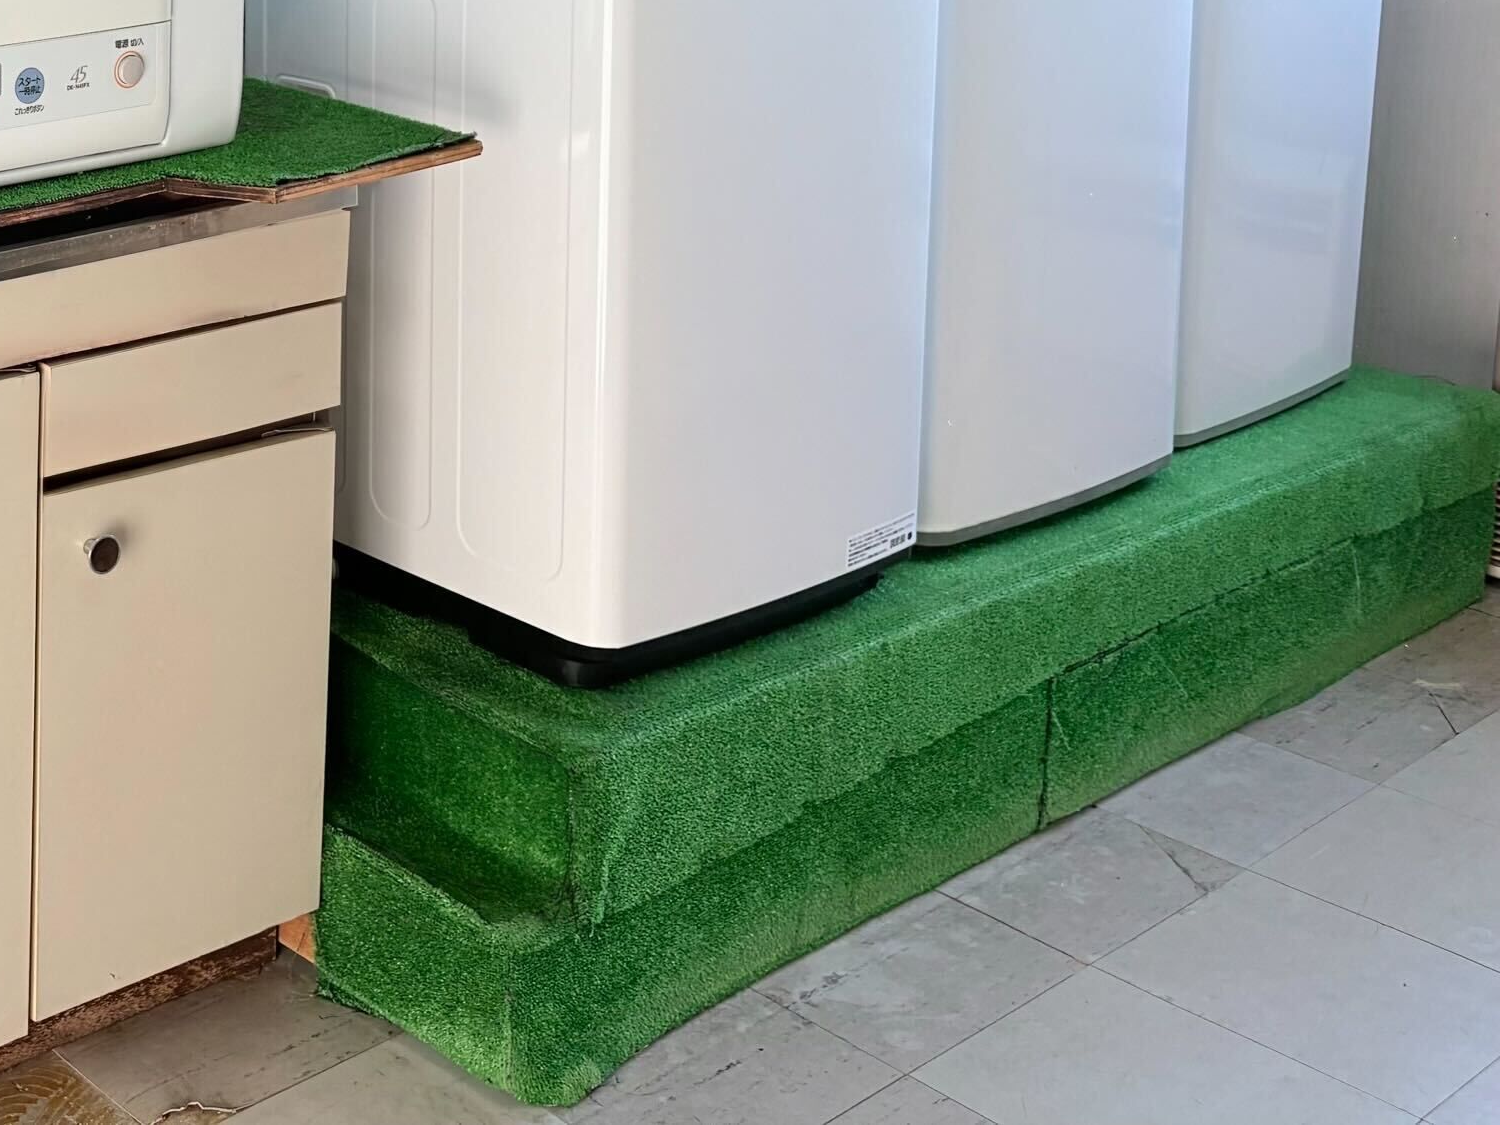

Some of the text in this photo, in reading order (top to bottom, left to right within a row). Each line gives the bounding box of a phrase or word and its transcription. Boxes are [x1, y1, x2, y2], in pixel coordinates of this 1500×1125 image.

[114, 38, 129, 49] 電源
[69, 65, 88, 84] 45
[19, 75, 41, 87] スタート
